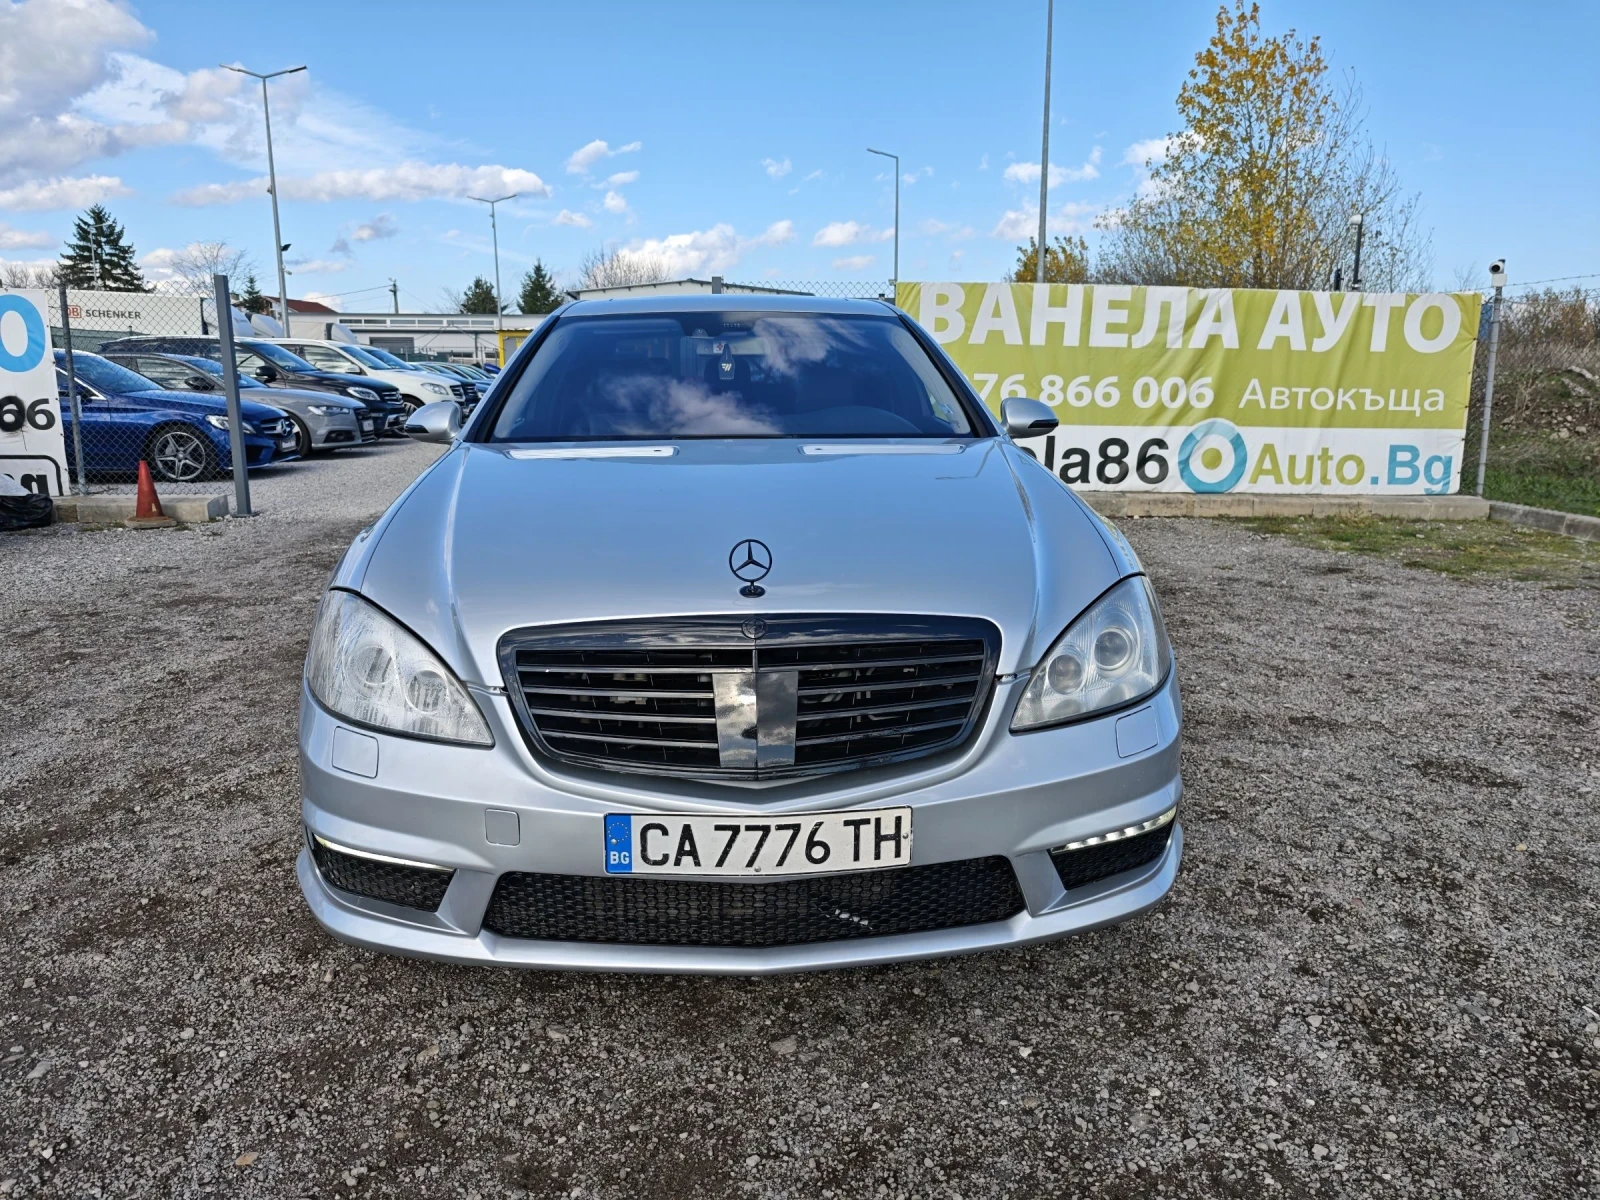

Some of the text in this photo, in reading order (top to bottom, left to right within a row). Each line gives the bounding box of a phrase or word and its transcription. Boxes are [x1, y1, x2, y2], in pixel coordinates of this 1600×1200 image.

[85, 309, 142, 320] SCHENKER
[917, 283, 1462, 354] ВАНЕЛА АУТО
[966, 373, 1215, 409] 76 866 006
[1238, 378, 1445, 417] Автокъща
[1019, 435, 1453, 495] la86 Auto.Bg
[610, 851, 630, 865] BG
[639, 815, 902, 867] CA 7776 TH
